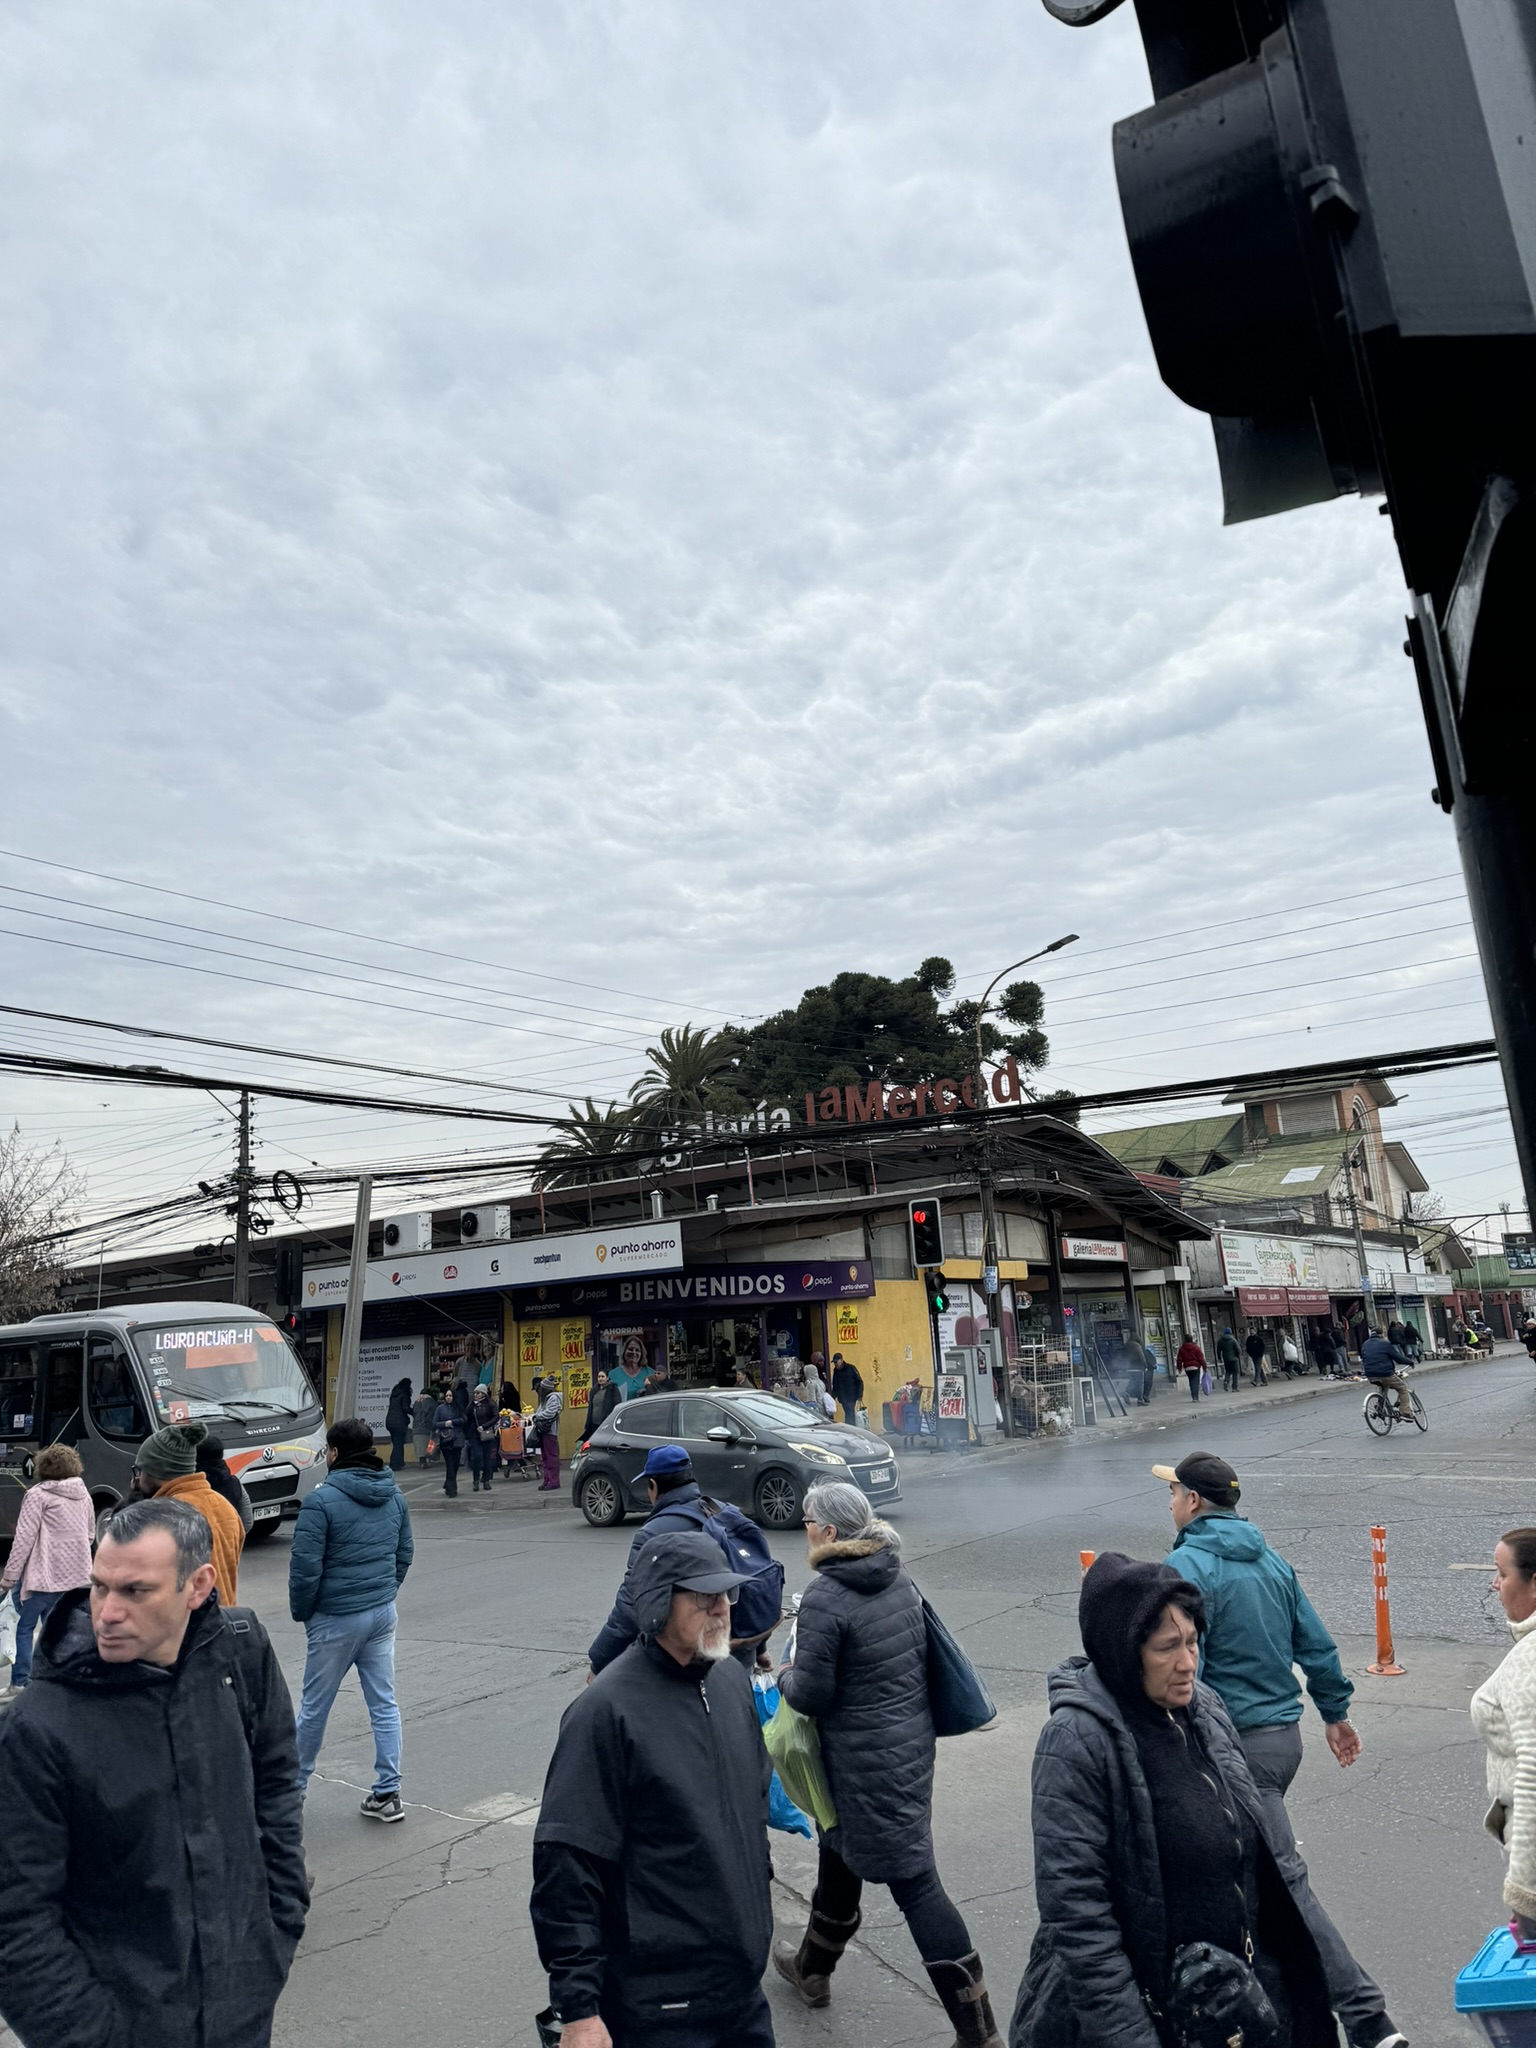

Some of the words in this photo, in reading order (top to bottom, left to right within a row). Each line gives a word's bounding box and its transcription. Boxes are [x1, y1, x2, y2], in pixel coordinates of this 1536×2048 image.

[611, 1242, 640, 1257] punto
[641, 1239, 676, 1252] ahorro
[619, 1252, 668, 1262] SUPERMERCADO
[401, 1272, 417, 1283] pepsi
[814, 1275, 833, 1288] pepsi
[318, 1279, 339, 1293] punto
[620, 1273, 786, 1302] BIENVENIDOS
[585, 1288, 608, 1300] pepsi
[602, 1326, 644, 1337] AHORRAR
[359, 1346, 371, 1356] Aquí
[371, 1345, 401, 1354] encuentras
[402, 1343, 414, 1351] todo
[364, 1356, 374, 1364] que
[374, 1353, 400, 1362] necesitas
[174, 1408, 184, 1420] 6
